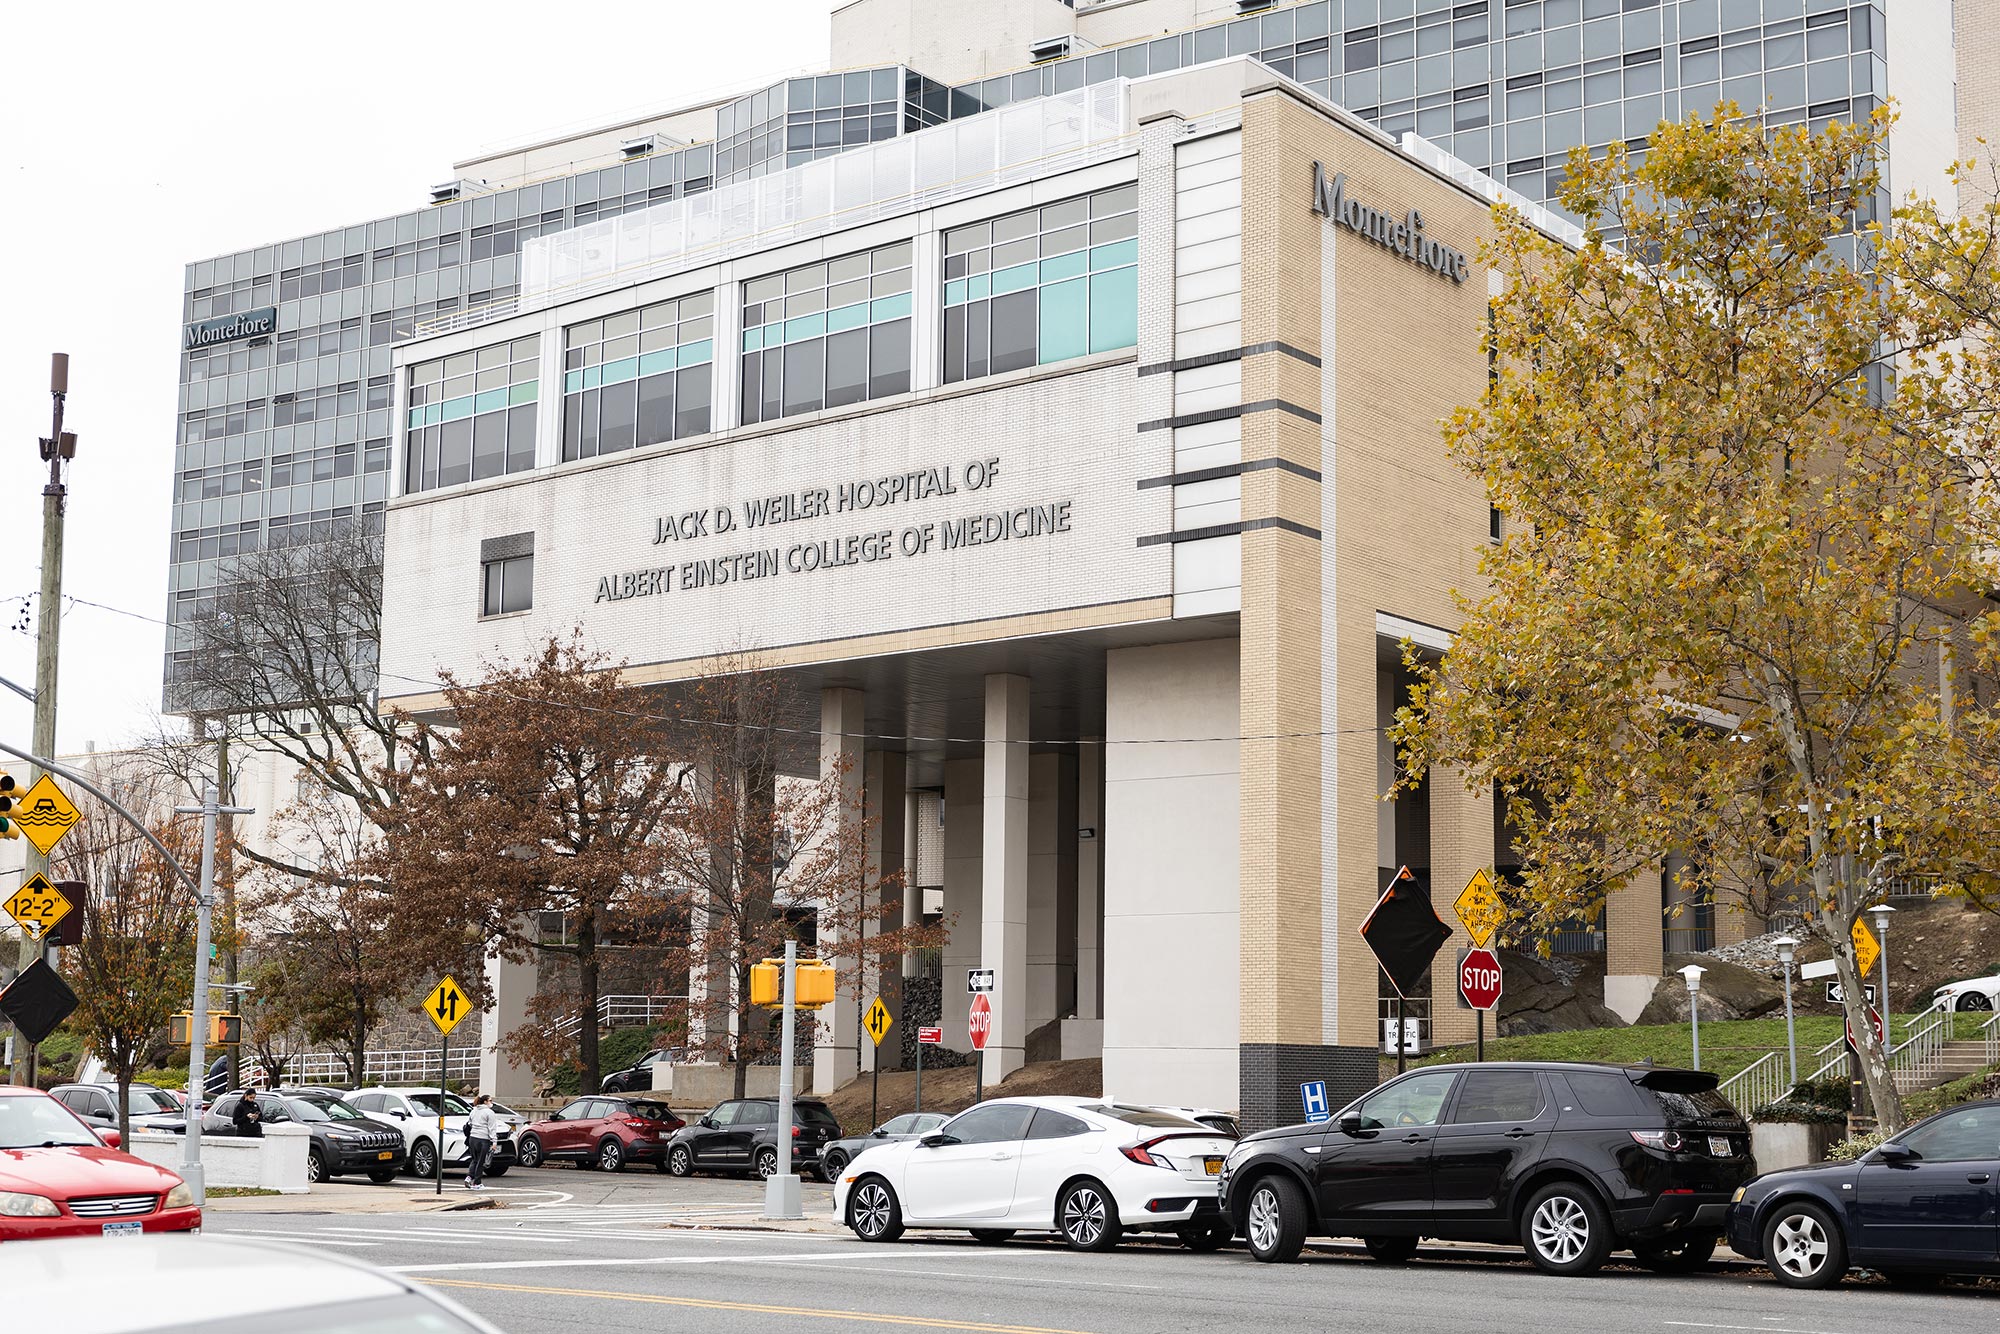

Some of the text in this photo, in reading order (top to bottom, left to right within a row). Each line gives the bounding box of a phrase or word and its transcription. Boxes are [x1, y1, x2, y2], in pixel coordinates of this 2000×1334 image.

[1313, 160, 1470, 284] Montefiore
[186, 314, 269, 347] Montefiore
[652, 457, 1000, 545] JACK D. WEILER HOSPITAL OF
[594, 500, 1073, 603] ALBERT EINSTEIN COLLEGE OF MEDICINE
[1853, 927, 1864, 935] TWO
[1856, 947, 1870, 955] AFFIC
[1464, 967, 1500, 991] STOP
[970, 1011, 991, 1032] STOP
[1393, 1021, 1411, 1029] AL
[1388, 1031, 1416, 1039] TRFIC
[1304, 1083, 1325, 1113] H
